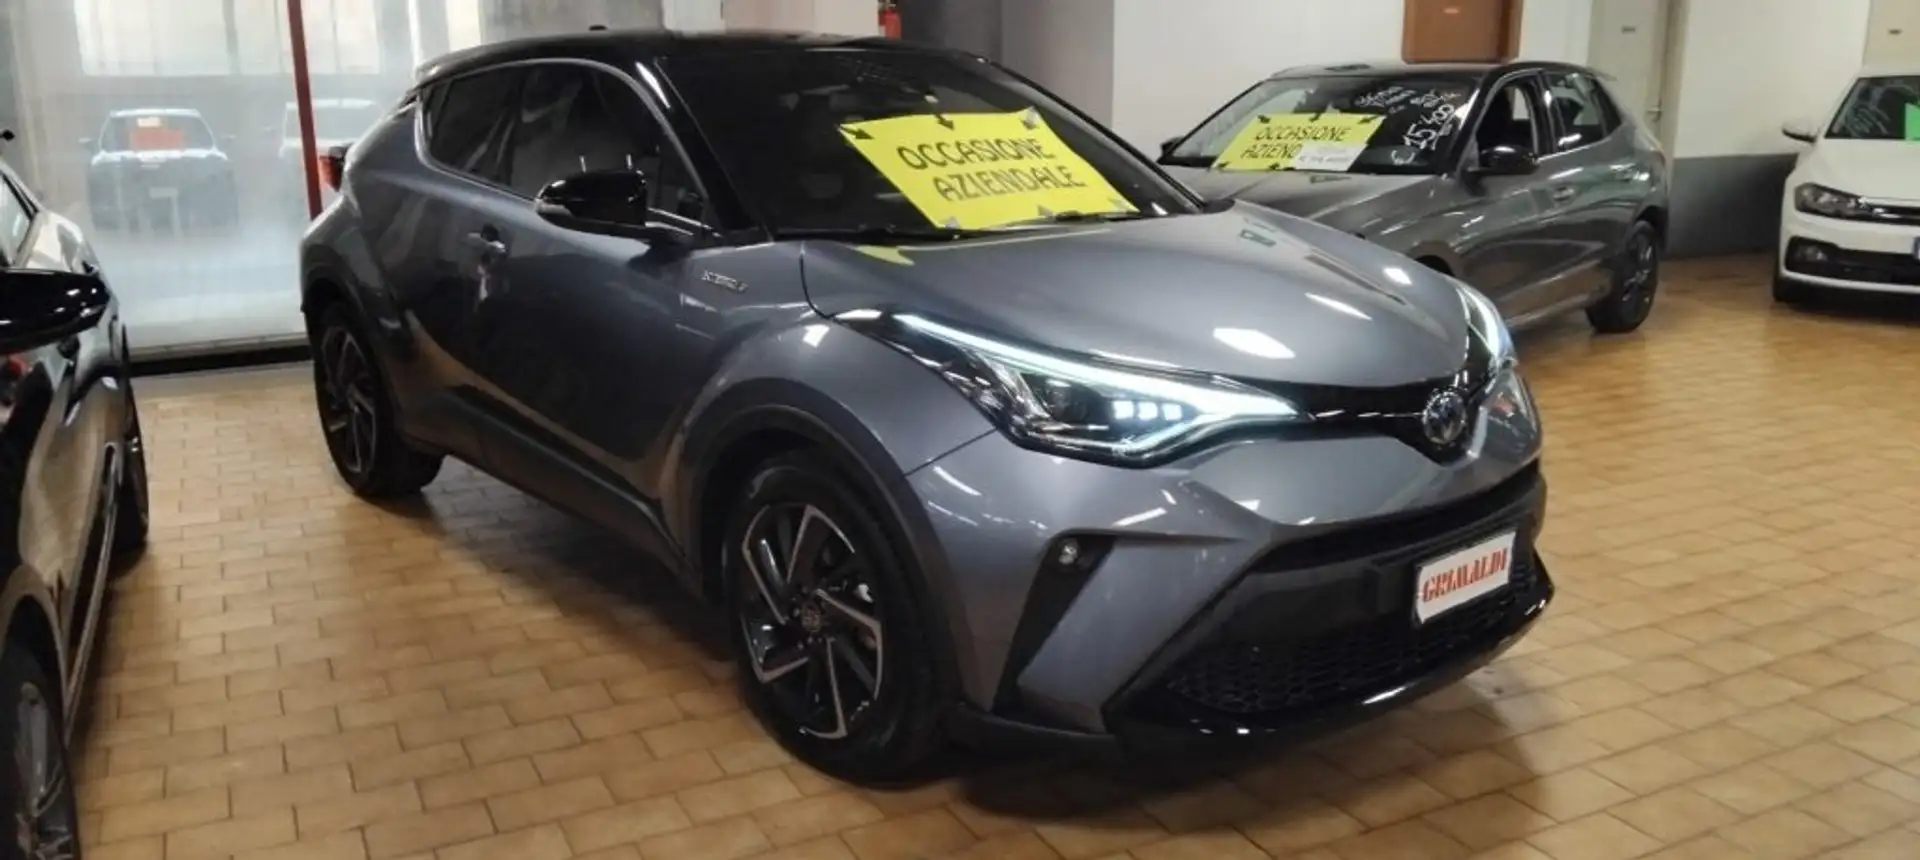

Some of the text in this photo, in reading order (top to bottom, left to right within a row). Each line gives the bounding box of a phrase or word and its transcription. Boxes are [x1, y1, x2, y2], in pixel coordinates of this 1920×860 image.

[1254, 125, 1352, 143] OCCASIONE
[896, 138, 1057, 170] OCCASIONE
[932, 165, 1088, 202] AZIENDALE
[1421, 547, 1508, 603] GRIMALDI
